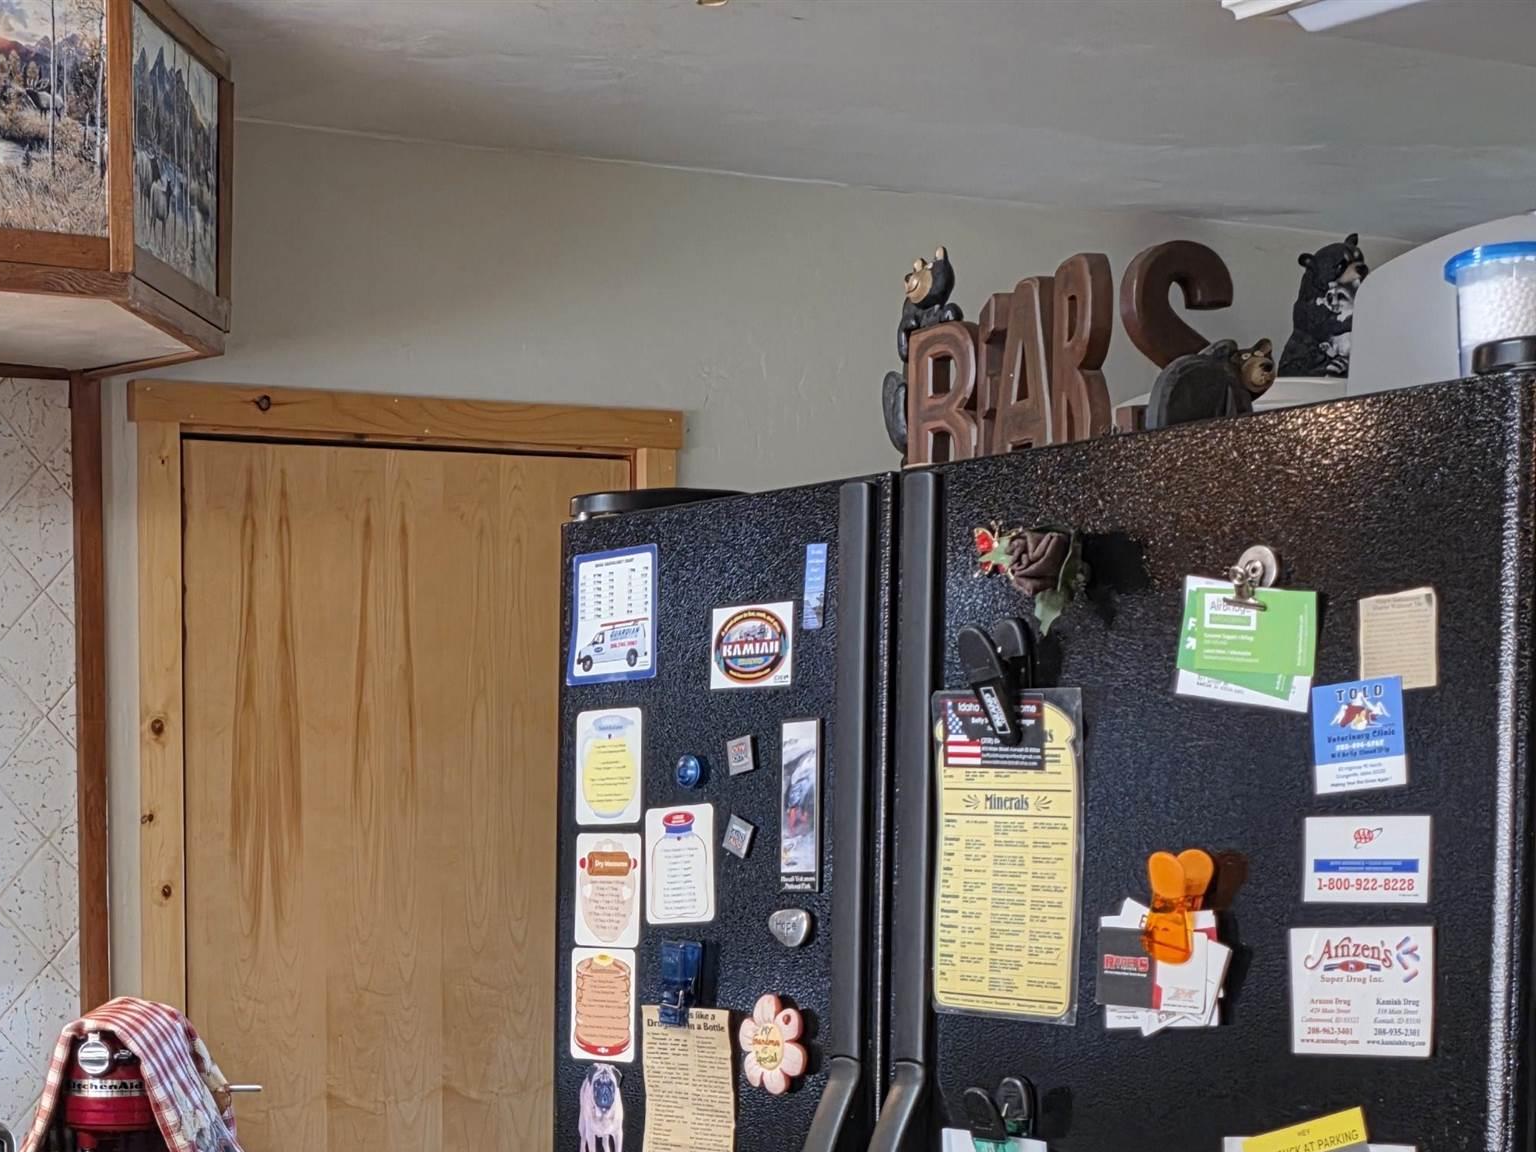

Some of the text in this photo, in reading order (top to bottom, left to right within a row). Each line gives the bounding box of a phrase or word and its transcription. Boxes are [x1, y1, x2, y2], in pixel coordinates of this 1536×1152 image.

[722, 641, 780, 657] KAMIAH
[957, 702, 980, 712] Idaho
[1372, 728, 1395, 737] Clinic
[984, 794, 1030, 811] Minerals
[1317, 878, 1415, 891] 1-800-922-8228
[774, 918, 797, 936] Hope
[1304, 936, 1393, 970] Arnzen's
[1320, 975, 1344, 984] Super
[1346, 975, 1367, 984] Drug
[1403, 998, 1420, 1007] Drug
[703, 1023, 725, 1032] Bottle
[1297, 1128, 1311, 1137] HEY
[1317, 1129, 1359, 1150] PARKING
